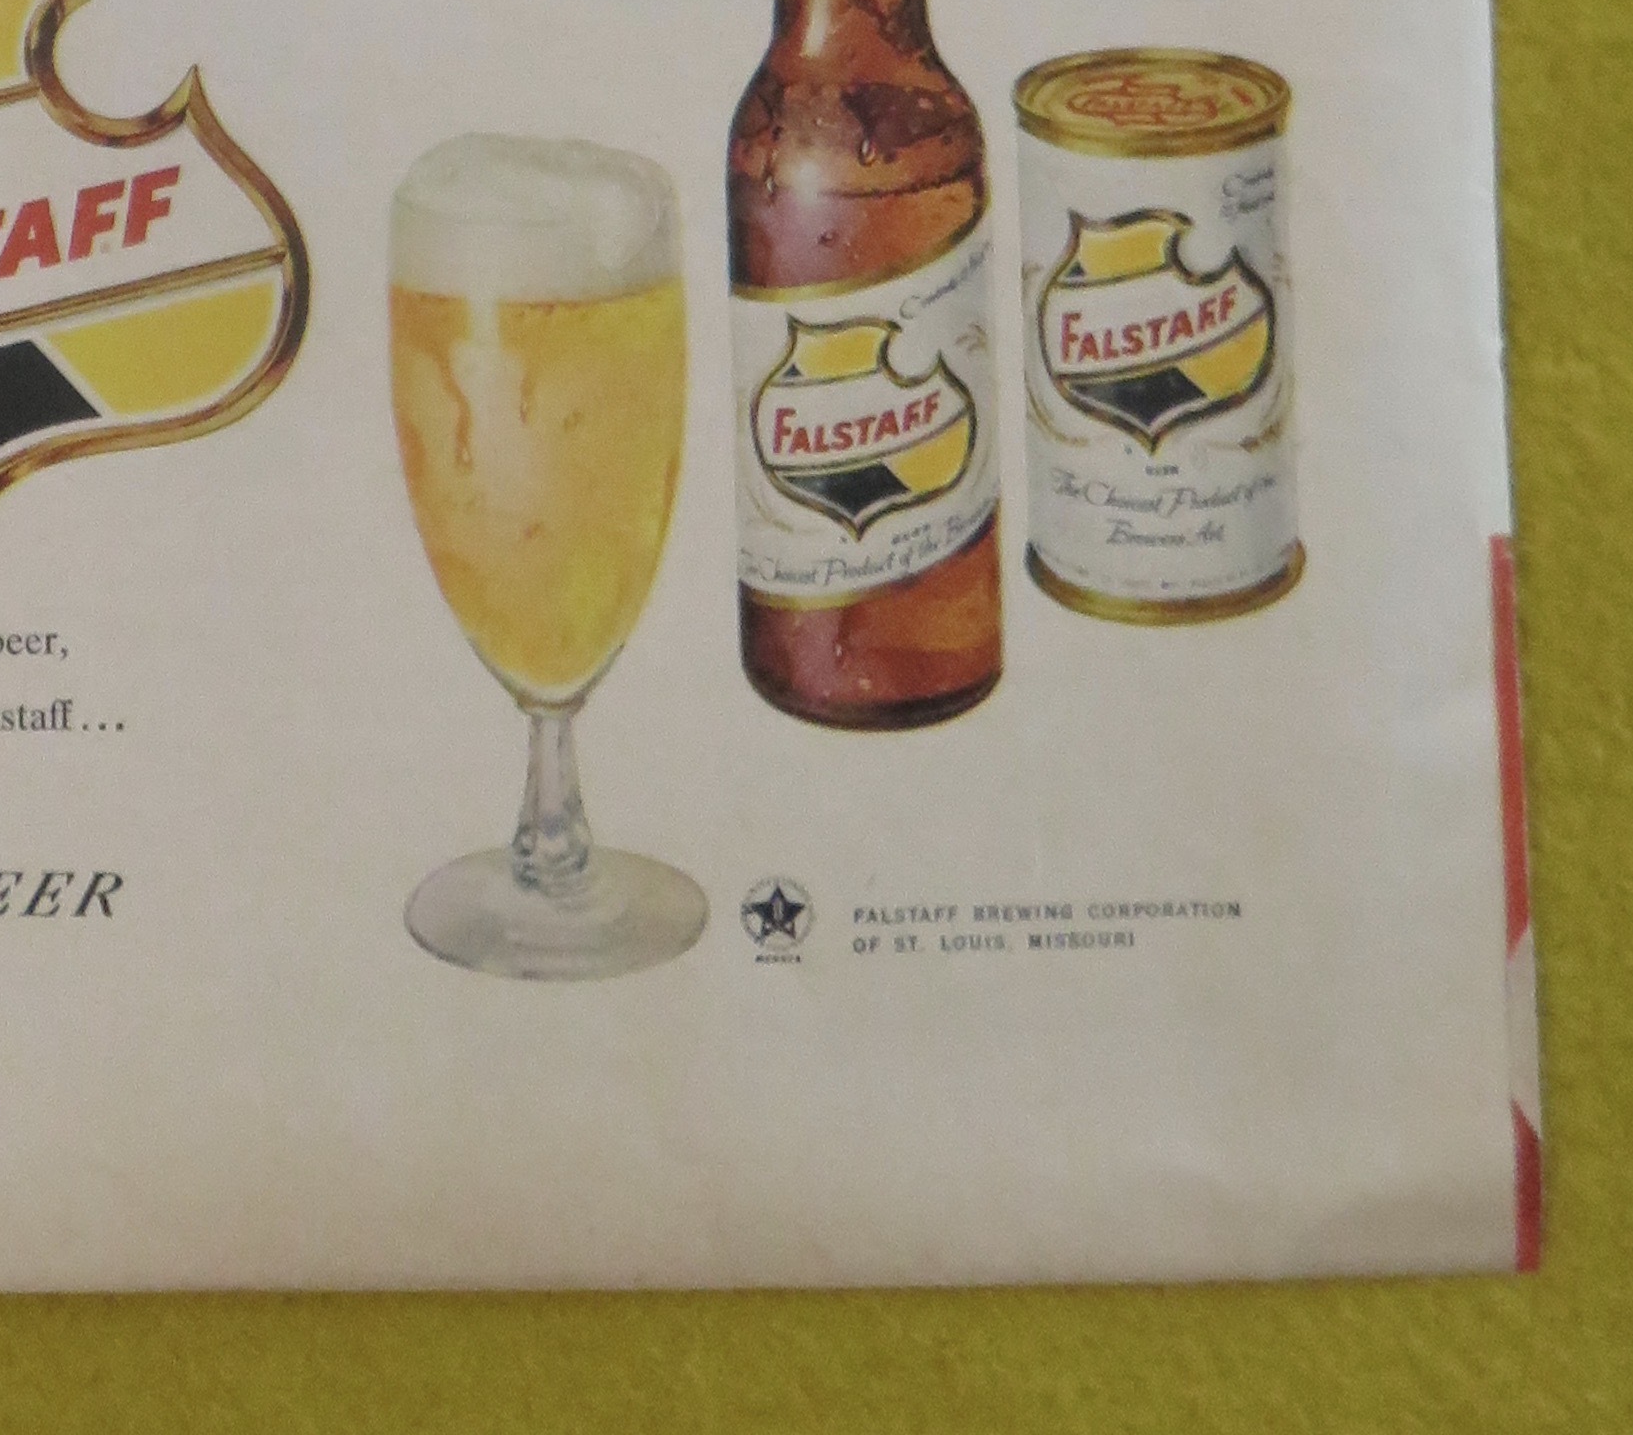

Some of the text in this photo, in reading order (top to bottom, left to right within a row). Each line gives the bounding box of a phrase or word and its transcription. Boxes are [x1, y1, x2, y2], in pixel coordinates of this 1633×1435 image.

[1060, 286, 1238, 364] FALSTAFF
[772, 390, 941, 455] FALSTAFF
[852, 900, 1243, 926] FALSTAFF BREWING CORPORATION
[851, 935, 881, 956] OF
[1027, 931, 1135, 950] MISSOURI
